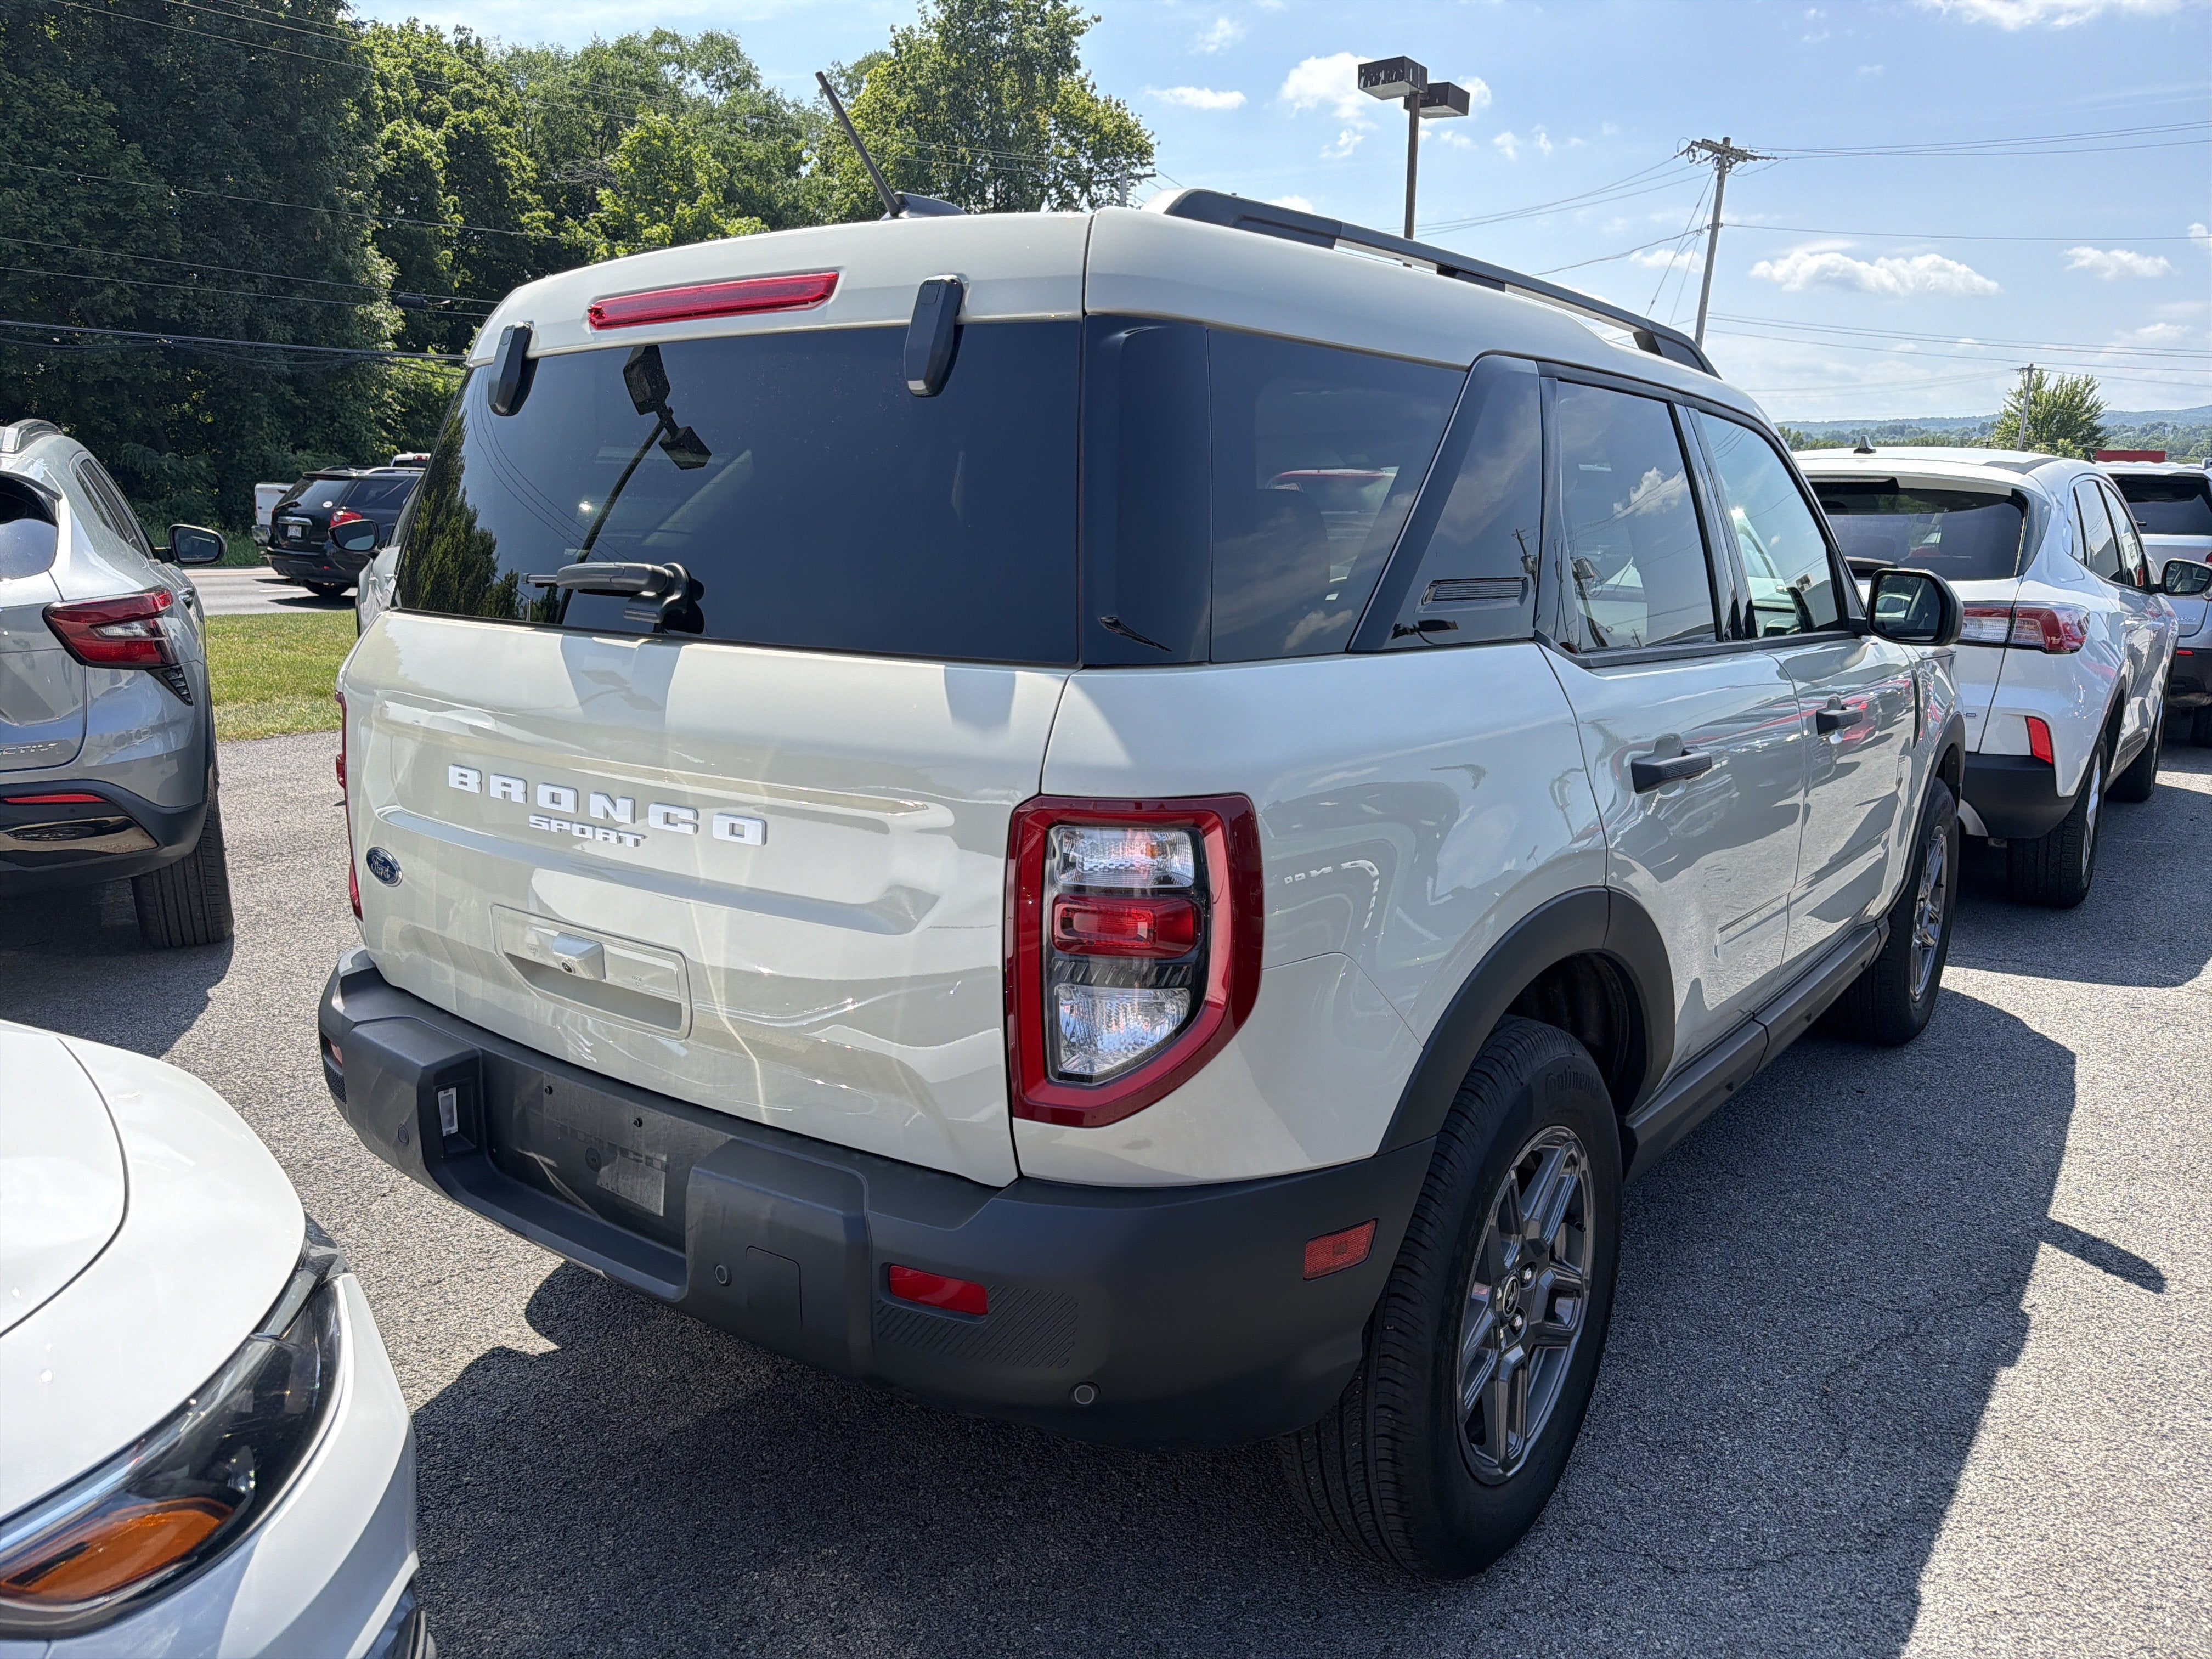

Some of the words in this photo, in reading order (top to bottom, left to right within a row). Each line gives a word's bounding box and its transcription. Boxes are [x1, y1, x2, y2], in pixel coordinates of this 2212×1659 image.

[0, 743, 58, 755] CTIV
[448, 764, 767, 847] BRONCO
[529, 814, 648, 848] SPORT
